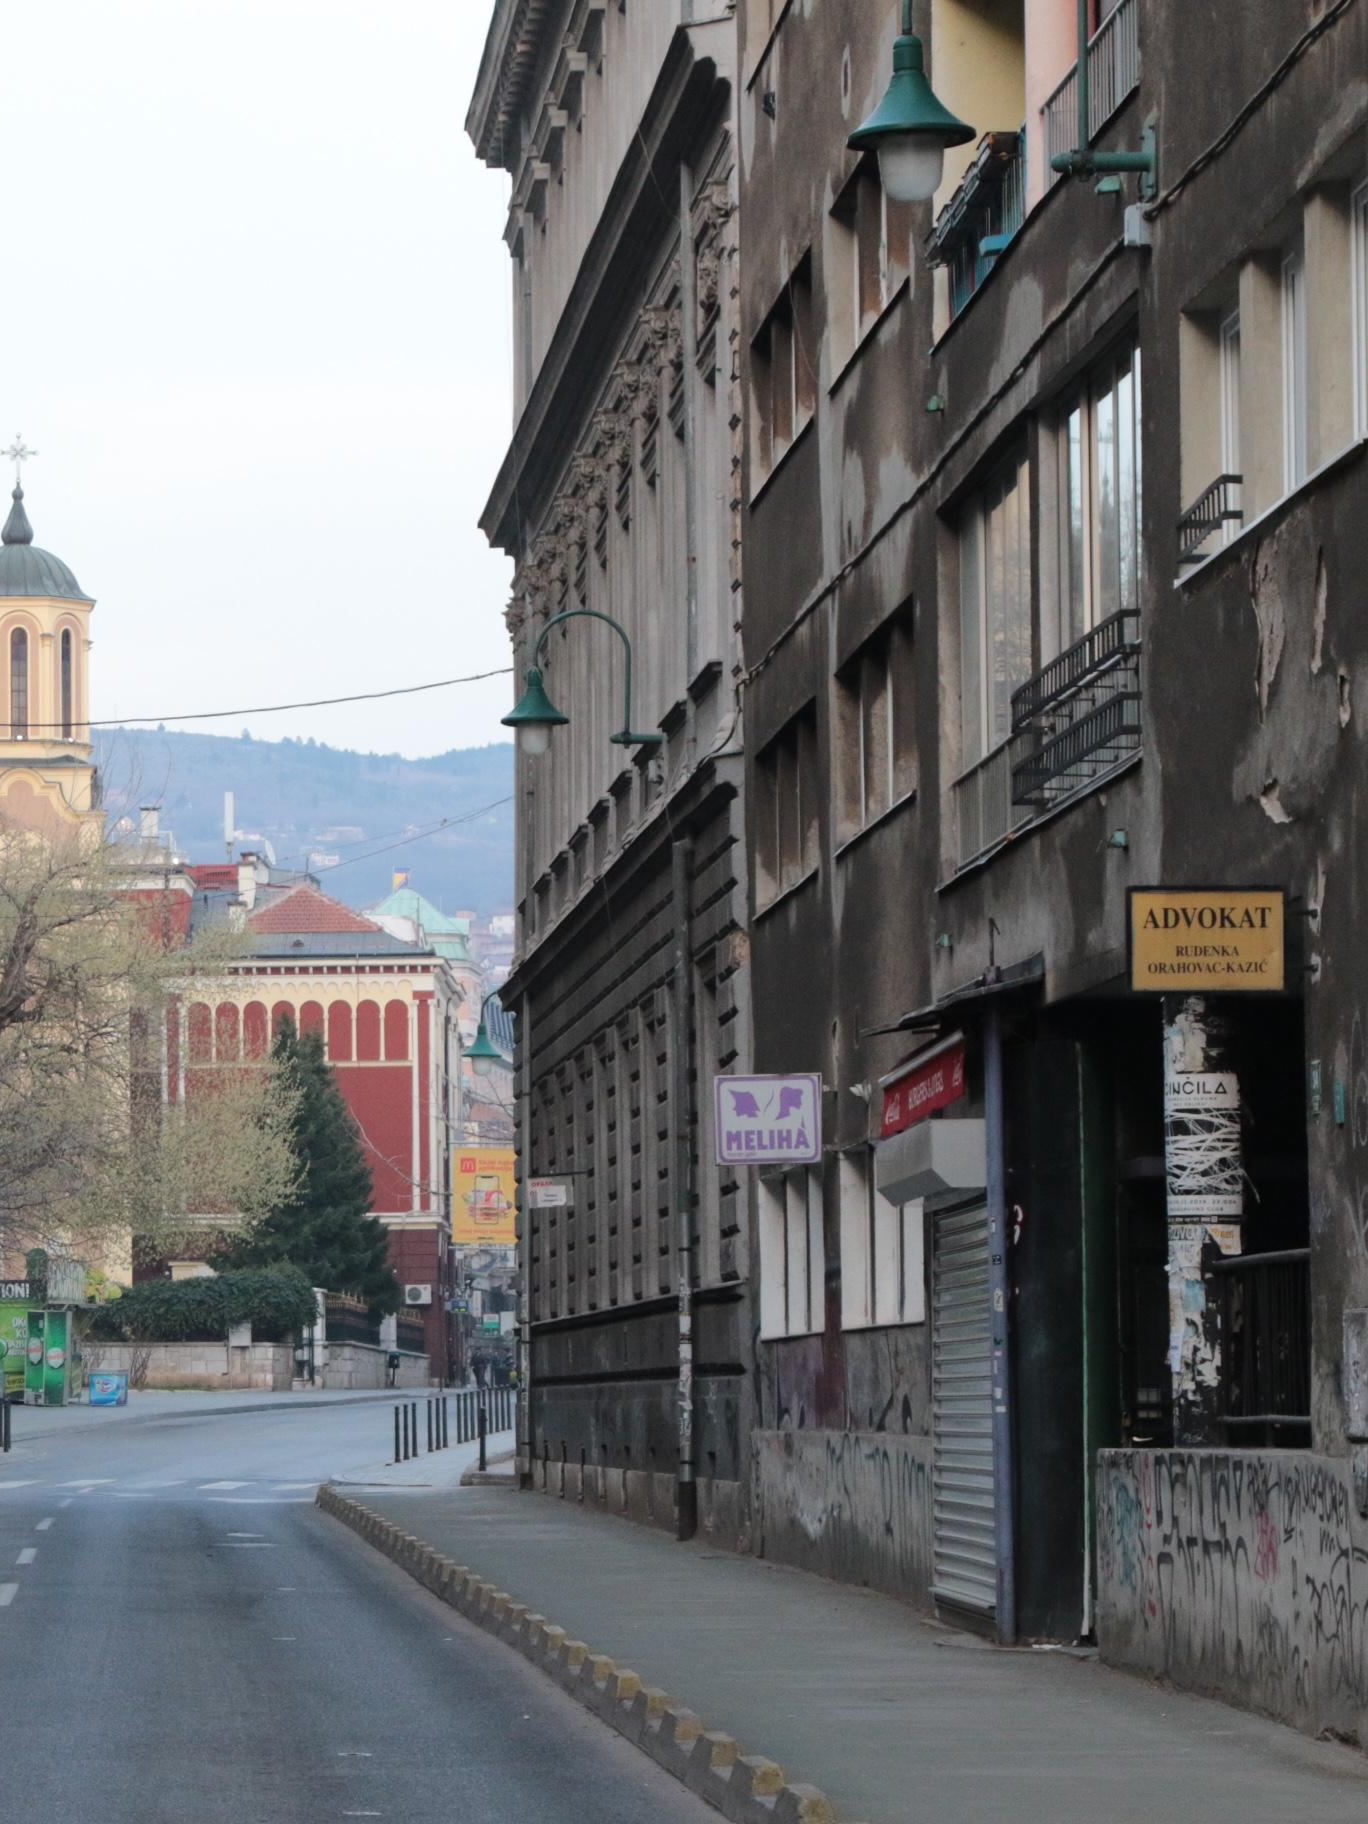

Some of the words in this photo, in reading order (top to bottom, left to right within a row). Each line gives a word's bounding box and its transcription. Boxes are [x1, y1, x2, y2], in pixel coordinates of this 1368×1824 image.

[1143, 906, 1272, 929] ADVOKAT
[1175, 945, 1240, 957] RUDENKA
[1147, 958, 1269, 974] ORAHOVAC-KAZIĆ
[726, 1128, 811, 1151] MELIHA
